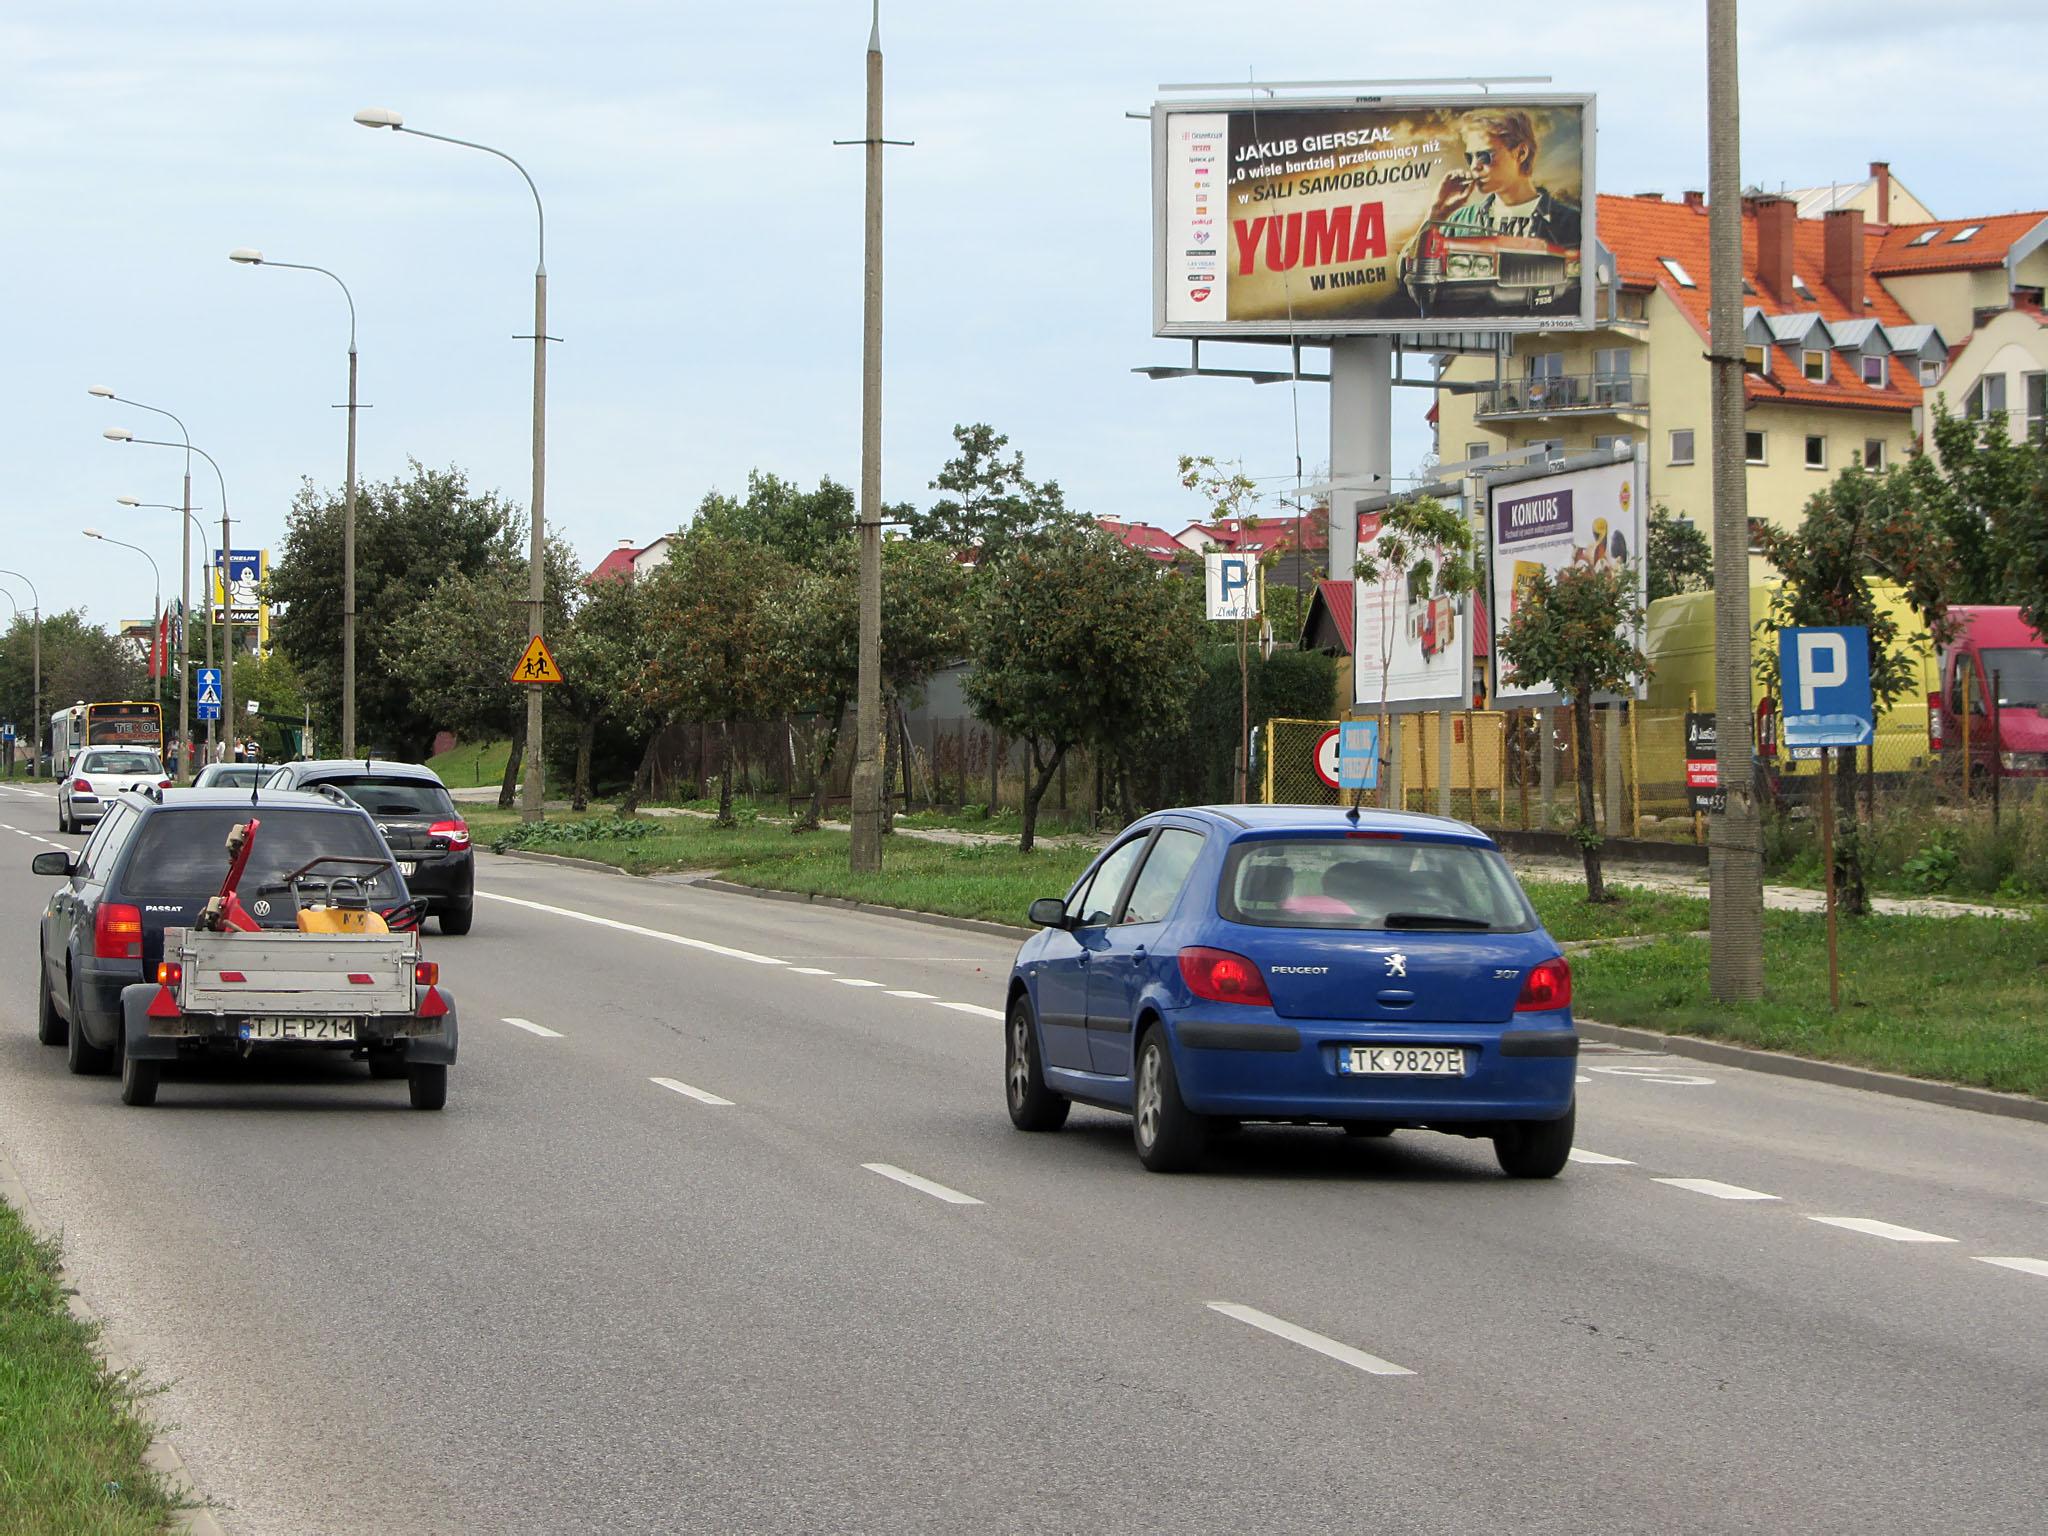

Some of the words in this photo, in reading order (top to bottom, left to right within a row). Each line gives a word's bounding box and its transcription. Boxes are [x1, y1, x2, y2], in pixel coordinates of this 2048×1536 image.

[1235, 141, 1298, 162] JAKUB
[1302, 127, 1394, 153] GIERSZAŁ
[1249, 162, 1282, 179] wiele
[1286, 154, 1335, 174] bardziej
[1338, 145, 1418, 168] przekonujący
[1422, 140, 1440, 153] niż
[1253, 181, 1293, 202] SALI
[1233, 202, 1387, 276] YUMA
[1310, 274, 1326, 291] W
[1330, 266, 1386, 289] KINACH
[1511, 497, 1559, 528] KONKURS
[1221, 559, 1247, 602] P
[1797, 632, 1848, 711] P
[1271, 966, 1329, 975] PEUGEOT
[1493, 969, 1520, 979] 307
